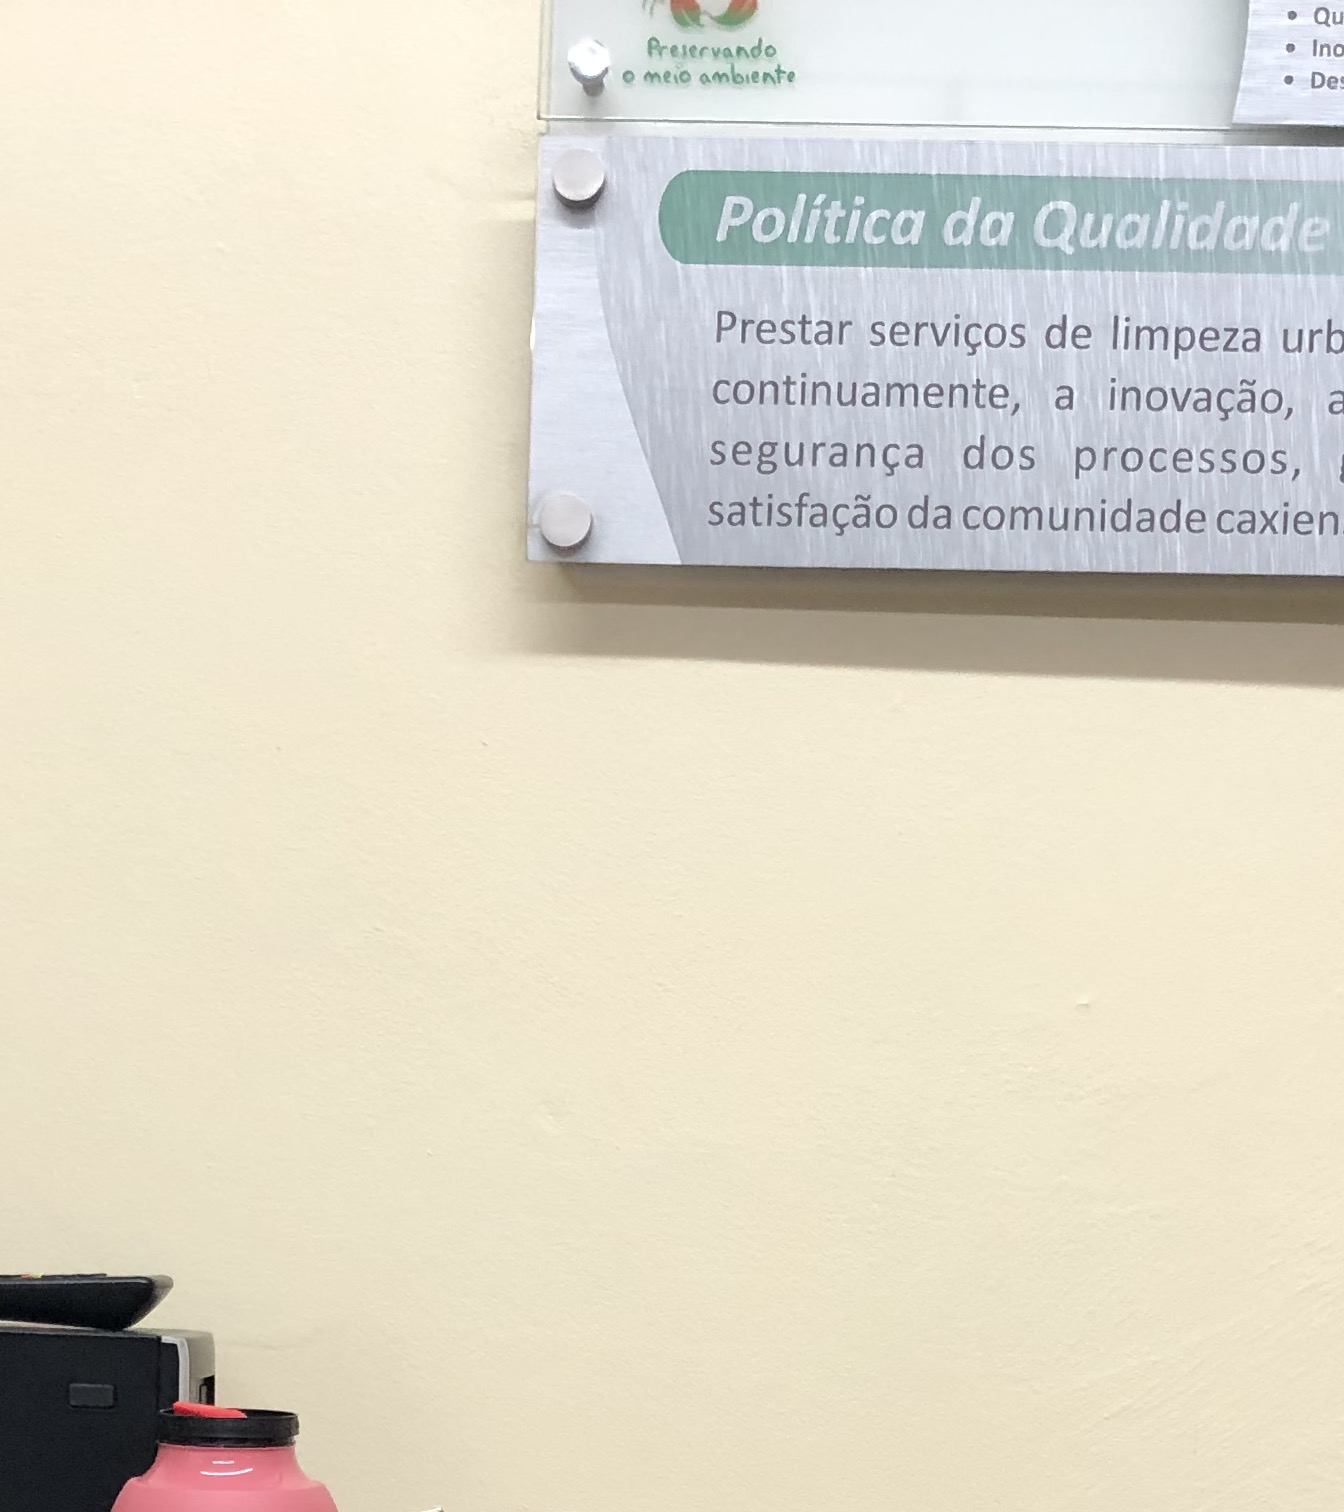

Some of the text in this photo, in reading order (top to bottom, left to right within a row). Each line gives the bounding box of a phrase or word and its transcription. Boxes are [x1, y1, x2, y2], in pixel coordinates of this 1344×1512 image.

[646, 36, 778, 59] Preservando
[622, 63, 797, 86] o meio ambiente
[715, 193, 1330, 256] Política da Qualidade
[714, 309, 852, 347] Prestar
[870, 313, 1026, 356] serviços
[1045, 314, 1092, 351] de
[1112, 315, 1261, 359] limpeza
[711, 372, 1021, 417] continuamente,
[1054, 384, 1075, 411] a
[1109, 377, 1295, 421] inovação,
[710, 439, 925, 477] segurança
[963, 435, 1036, 471] dos
[1075, 443, 1301, 481] processos,
[708, 492, 898, 536] satisfação
[907, 495, 953, 531] da
[963, 498, 1206, 533] comunidade
